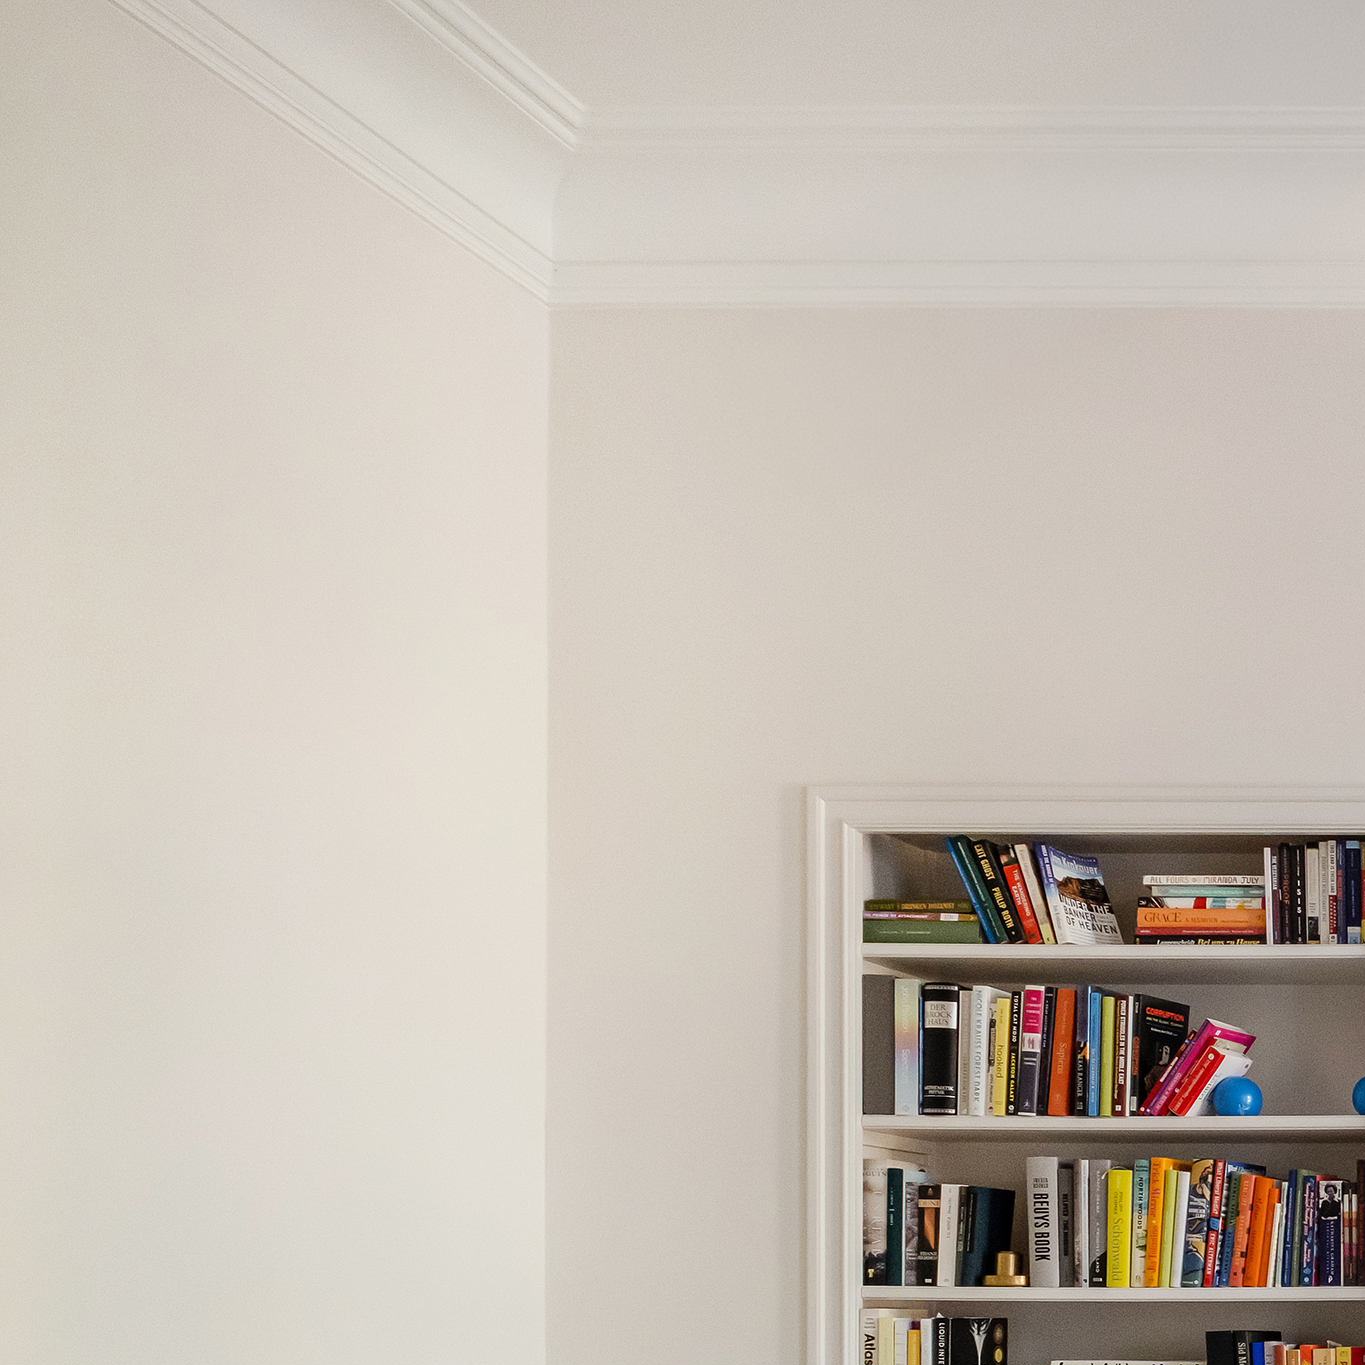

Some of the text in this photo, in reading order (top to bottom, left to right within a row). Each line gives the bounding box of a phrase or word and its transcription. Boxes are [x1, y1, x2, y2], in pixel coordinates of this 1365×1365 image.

[974, 844, 1014, 928] EXIT GHOST PHILIP ROTH
[1012, 886, 1022, 905] EARTH
[1017, 882, 1031, 916] WANDERING
[1059, 894, 1110, 915] UNDER THE
[1063, 905, 1097, 923] BANNER
[1144, 912, 1182, 922] GRACE
[1066, 916, 1118, 934] OF HEAVEN
[996, 1045, 1004, 1078] hooked
[1057, 1042, 1067, 1074] Sapiens
[1150, 1162, 1161, 1218] Trick Mirror
[1214, 1176, 1222, 1196] Liberal
[1033, 1193, 1051, 1262] BEUYS BOOK
[1111, 1217, 1126, 1282] Schönwald
[1206, 1247, 1214, 1275] ALTERMAN
[938, 1322, 946, 1347] LIQUID
[1238, 1342, 1246, 1355] Sid
[864, 1334, 876, 1365] Atlas
